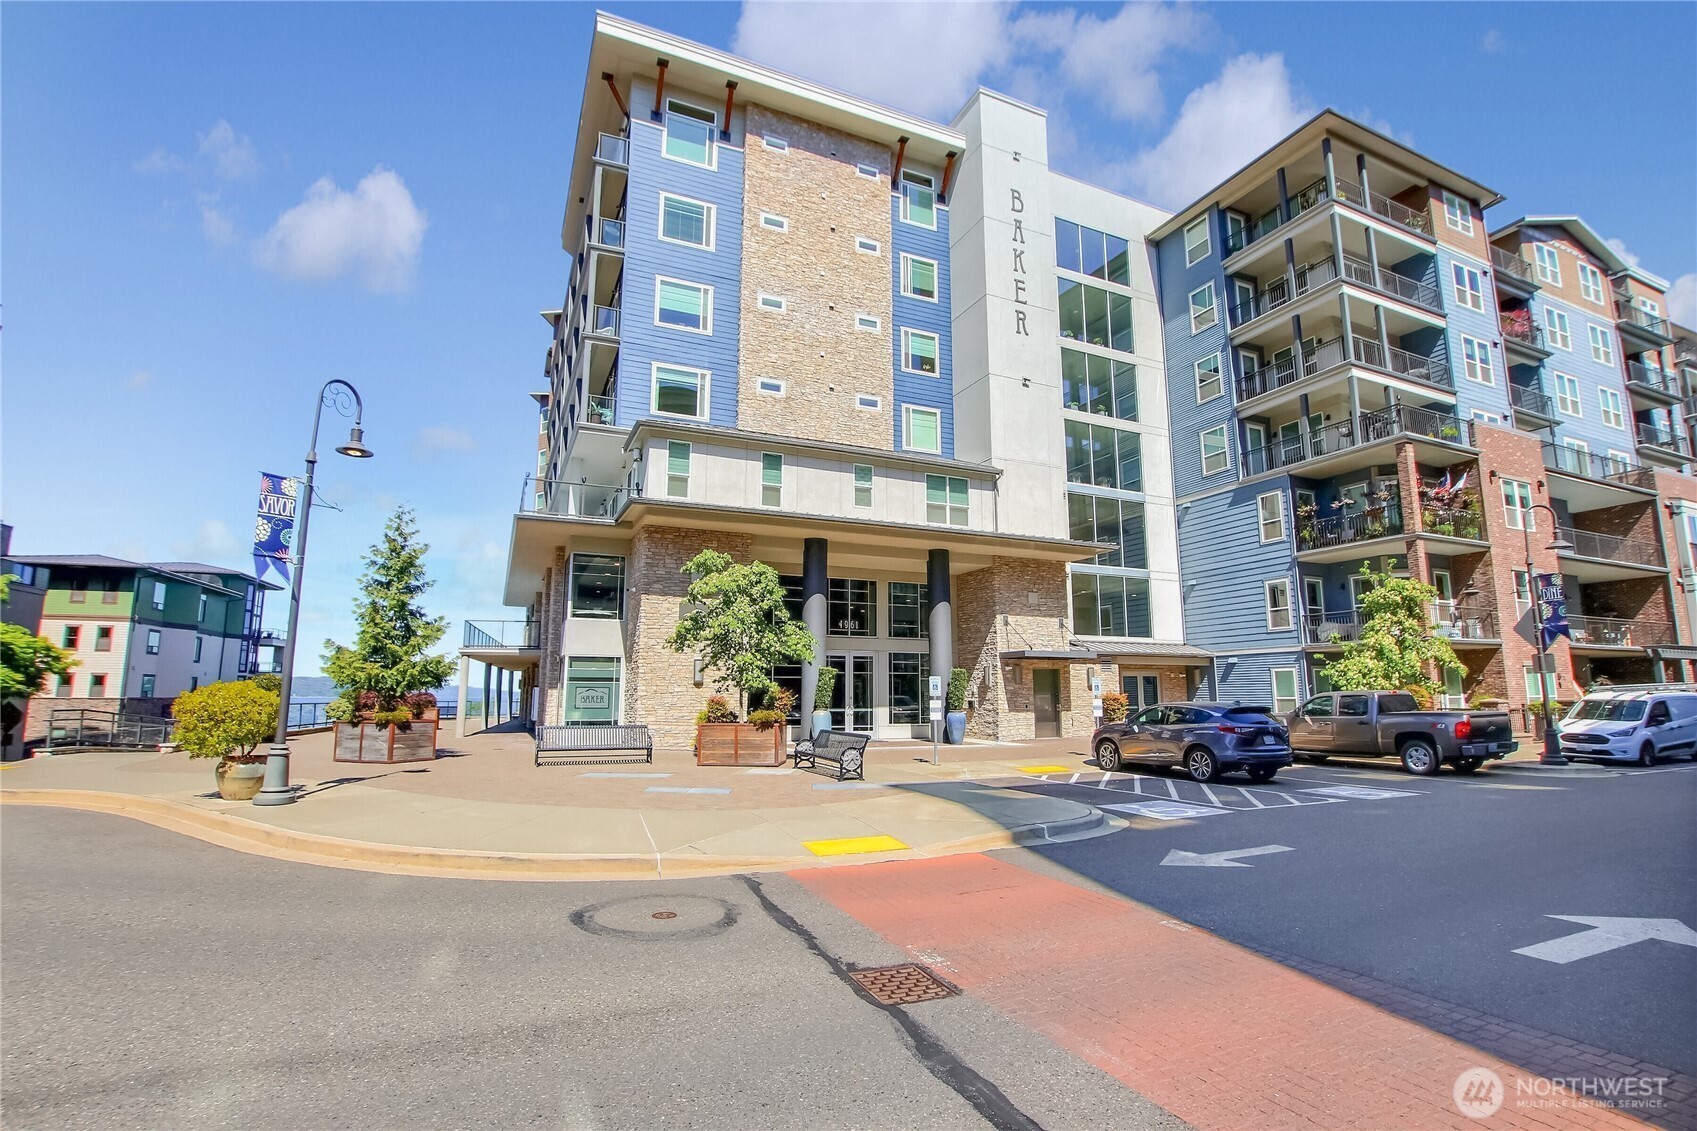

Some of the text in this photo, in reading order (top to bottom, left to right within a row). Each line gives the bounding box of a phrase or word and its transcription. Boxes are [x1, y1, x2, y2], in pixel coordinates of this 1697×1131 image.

[1010, 188, 1029, 336] BAKER
[258, 494, 295, 517] SAVOR
[1542, 587, 1564, 600] DINE
[580, 695, 605, 704] BAKER
